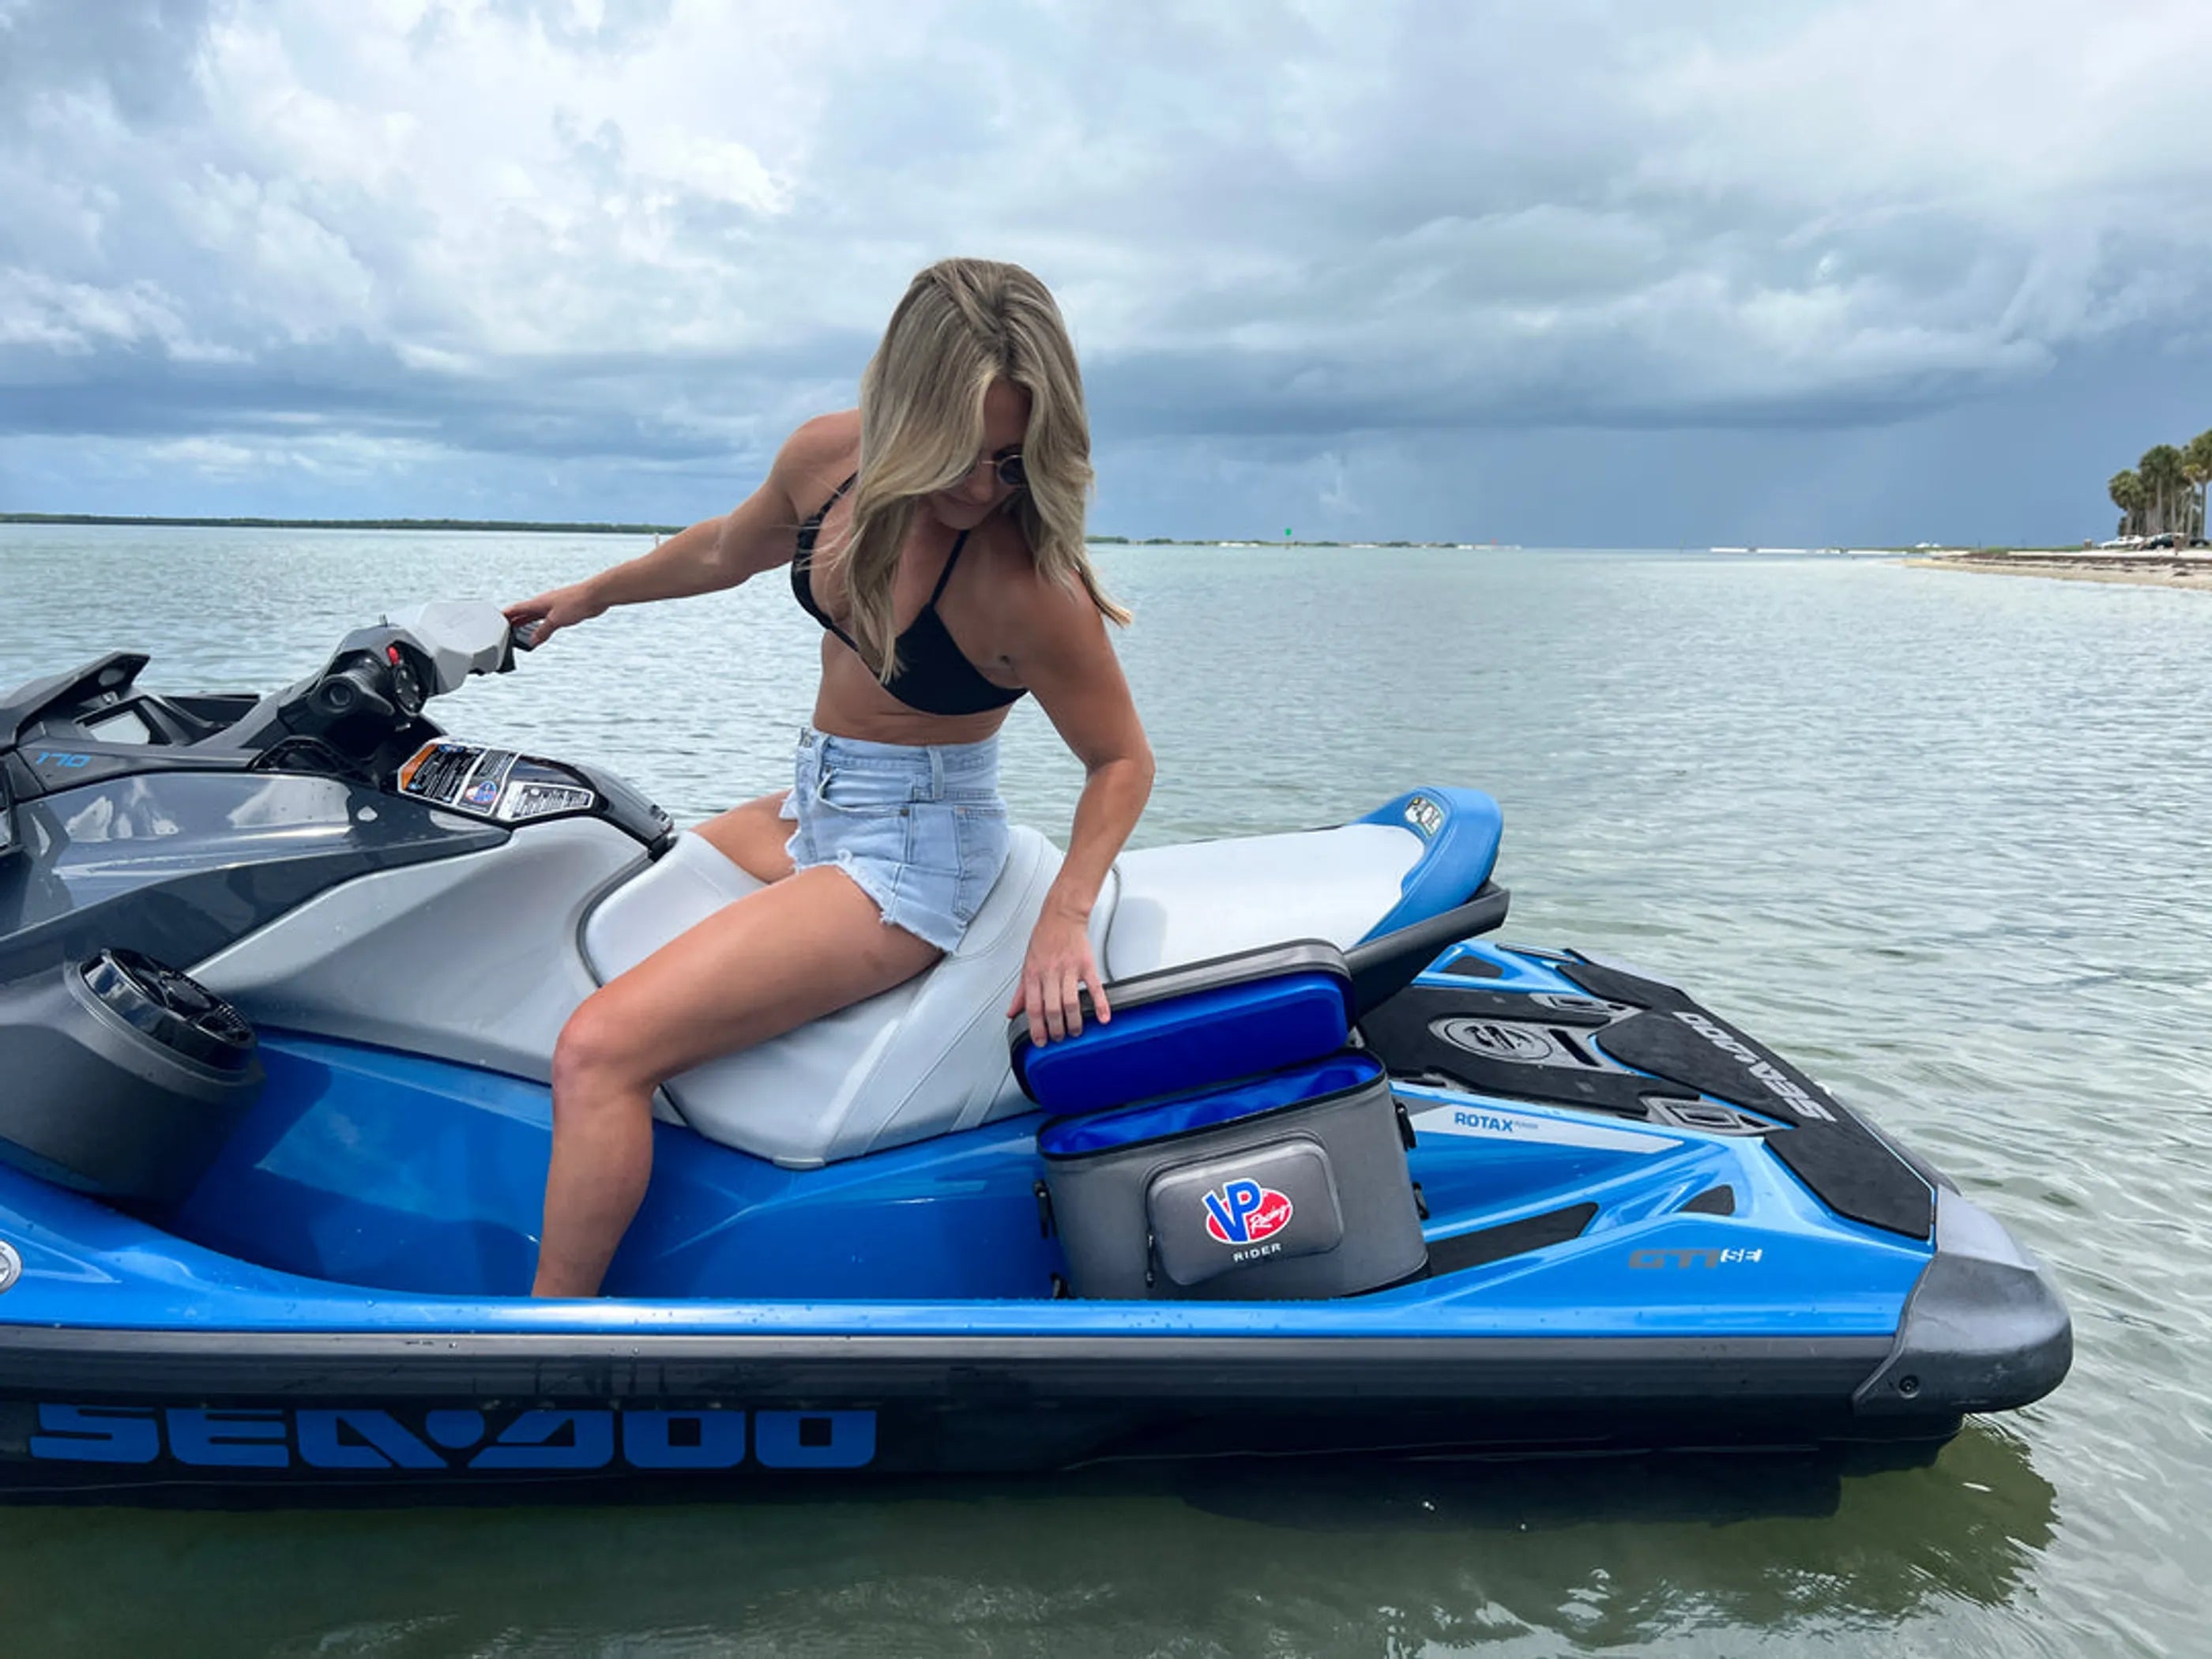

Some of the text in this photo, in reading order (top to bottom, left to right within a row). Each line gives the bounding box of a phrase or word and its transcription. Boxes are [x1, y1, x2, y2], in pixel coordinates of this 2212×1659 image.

[36, 751, 92, 767] 170
[1454, 1112, 1513, 1132] ROTAX
[1202, 1179, 1262, 1243] VP
[1232, 1243, 1281, 1262] RIDER
[1628, 1248, 1721, 1269] GTI
